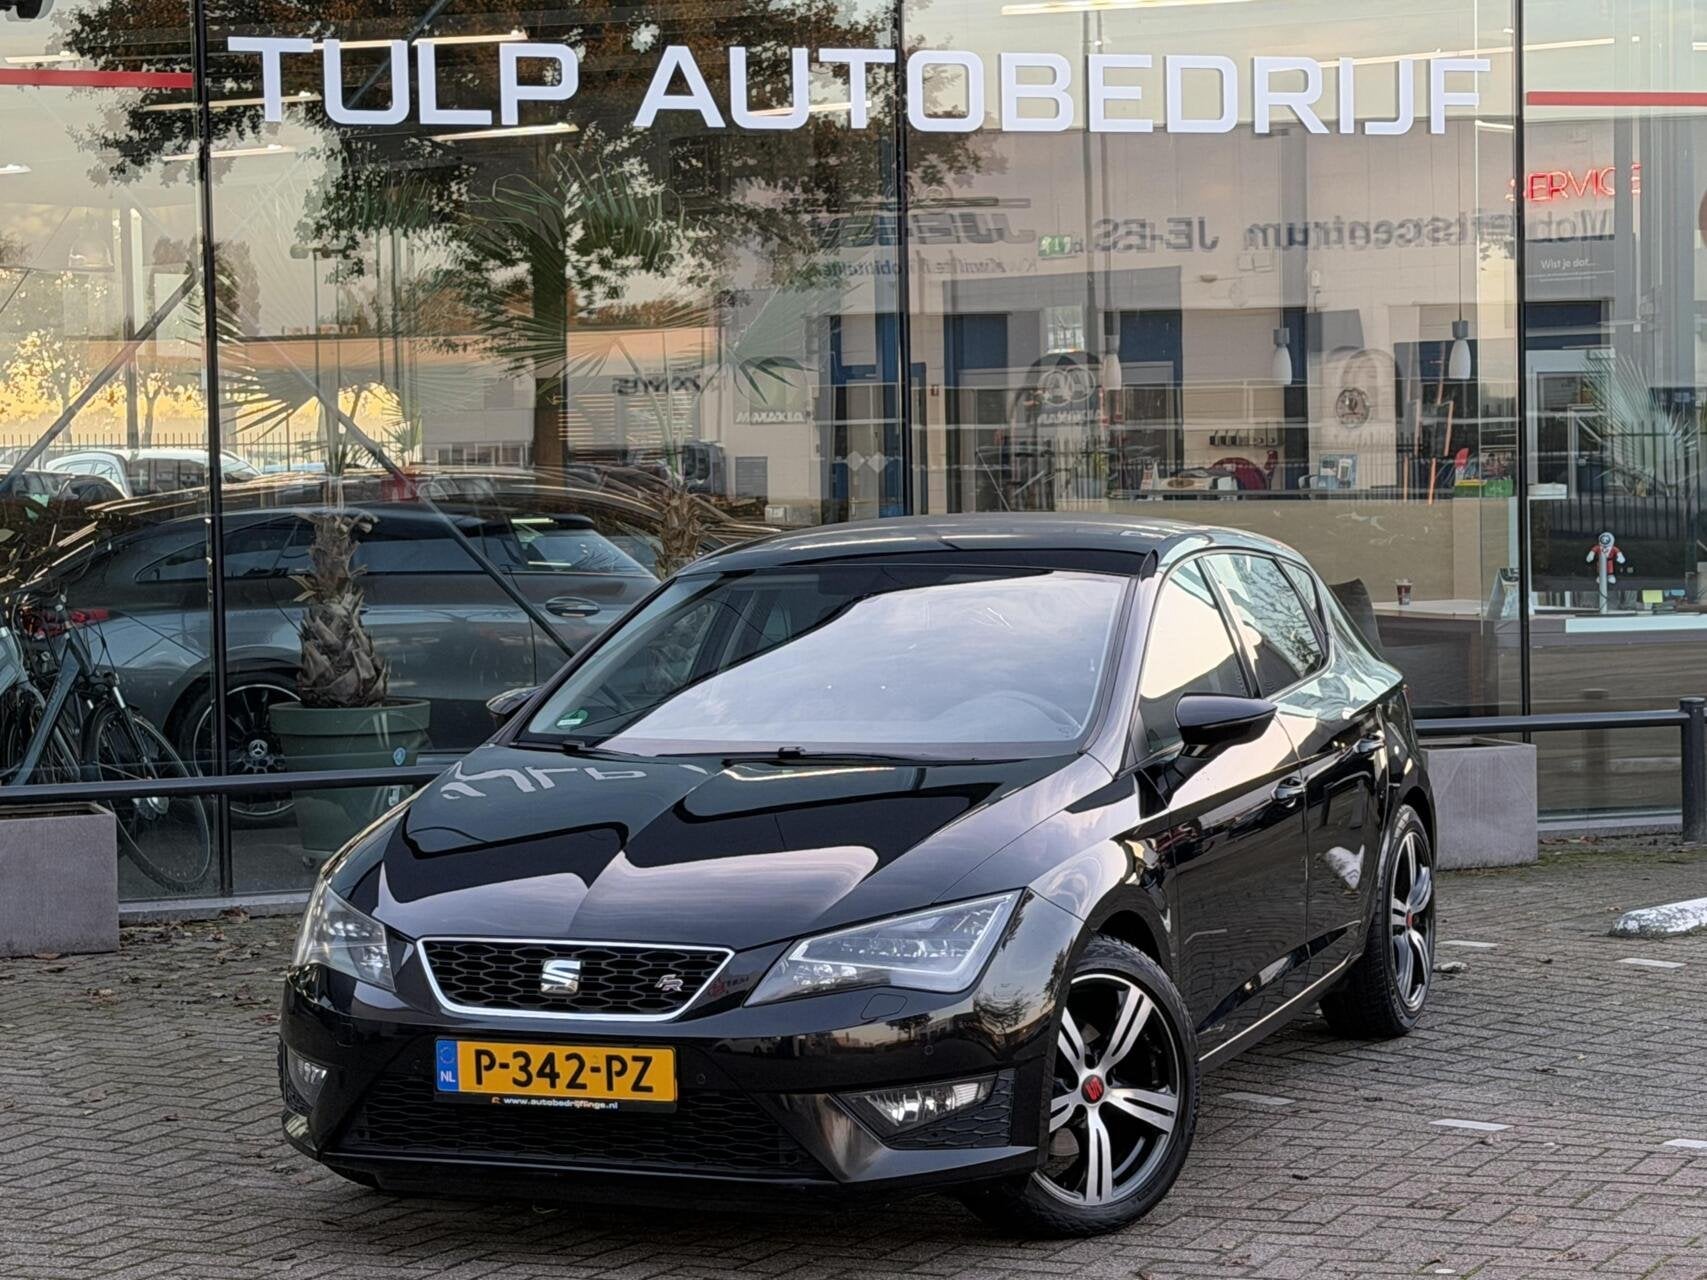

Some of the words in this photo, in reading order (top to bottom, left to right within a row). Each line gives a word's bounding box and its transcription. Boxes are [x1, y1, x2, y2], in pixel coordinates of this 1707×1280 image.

[228, 36, 578, 126] TULP
[633, 45, 1491, 135] AUTOBEDRIJF
[1540, 259, 1561, 270] Wist
[1562, 259, 1572, 270] je
[440, 1071, 456, 1083] NL
[474, 1048, 654, 1093] P-342-PZ
